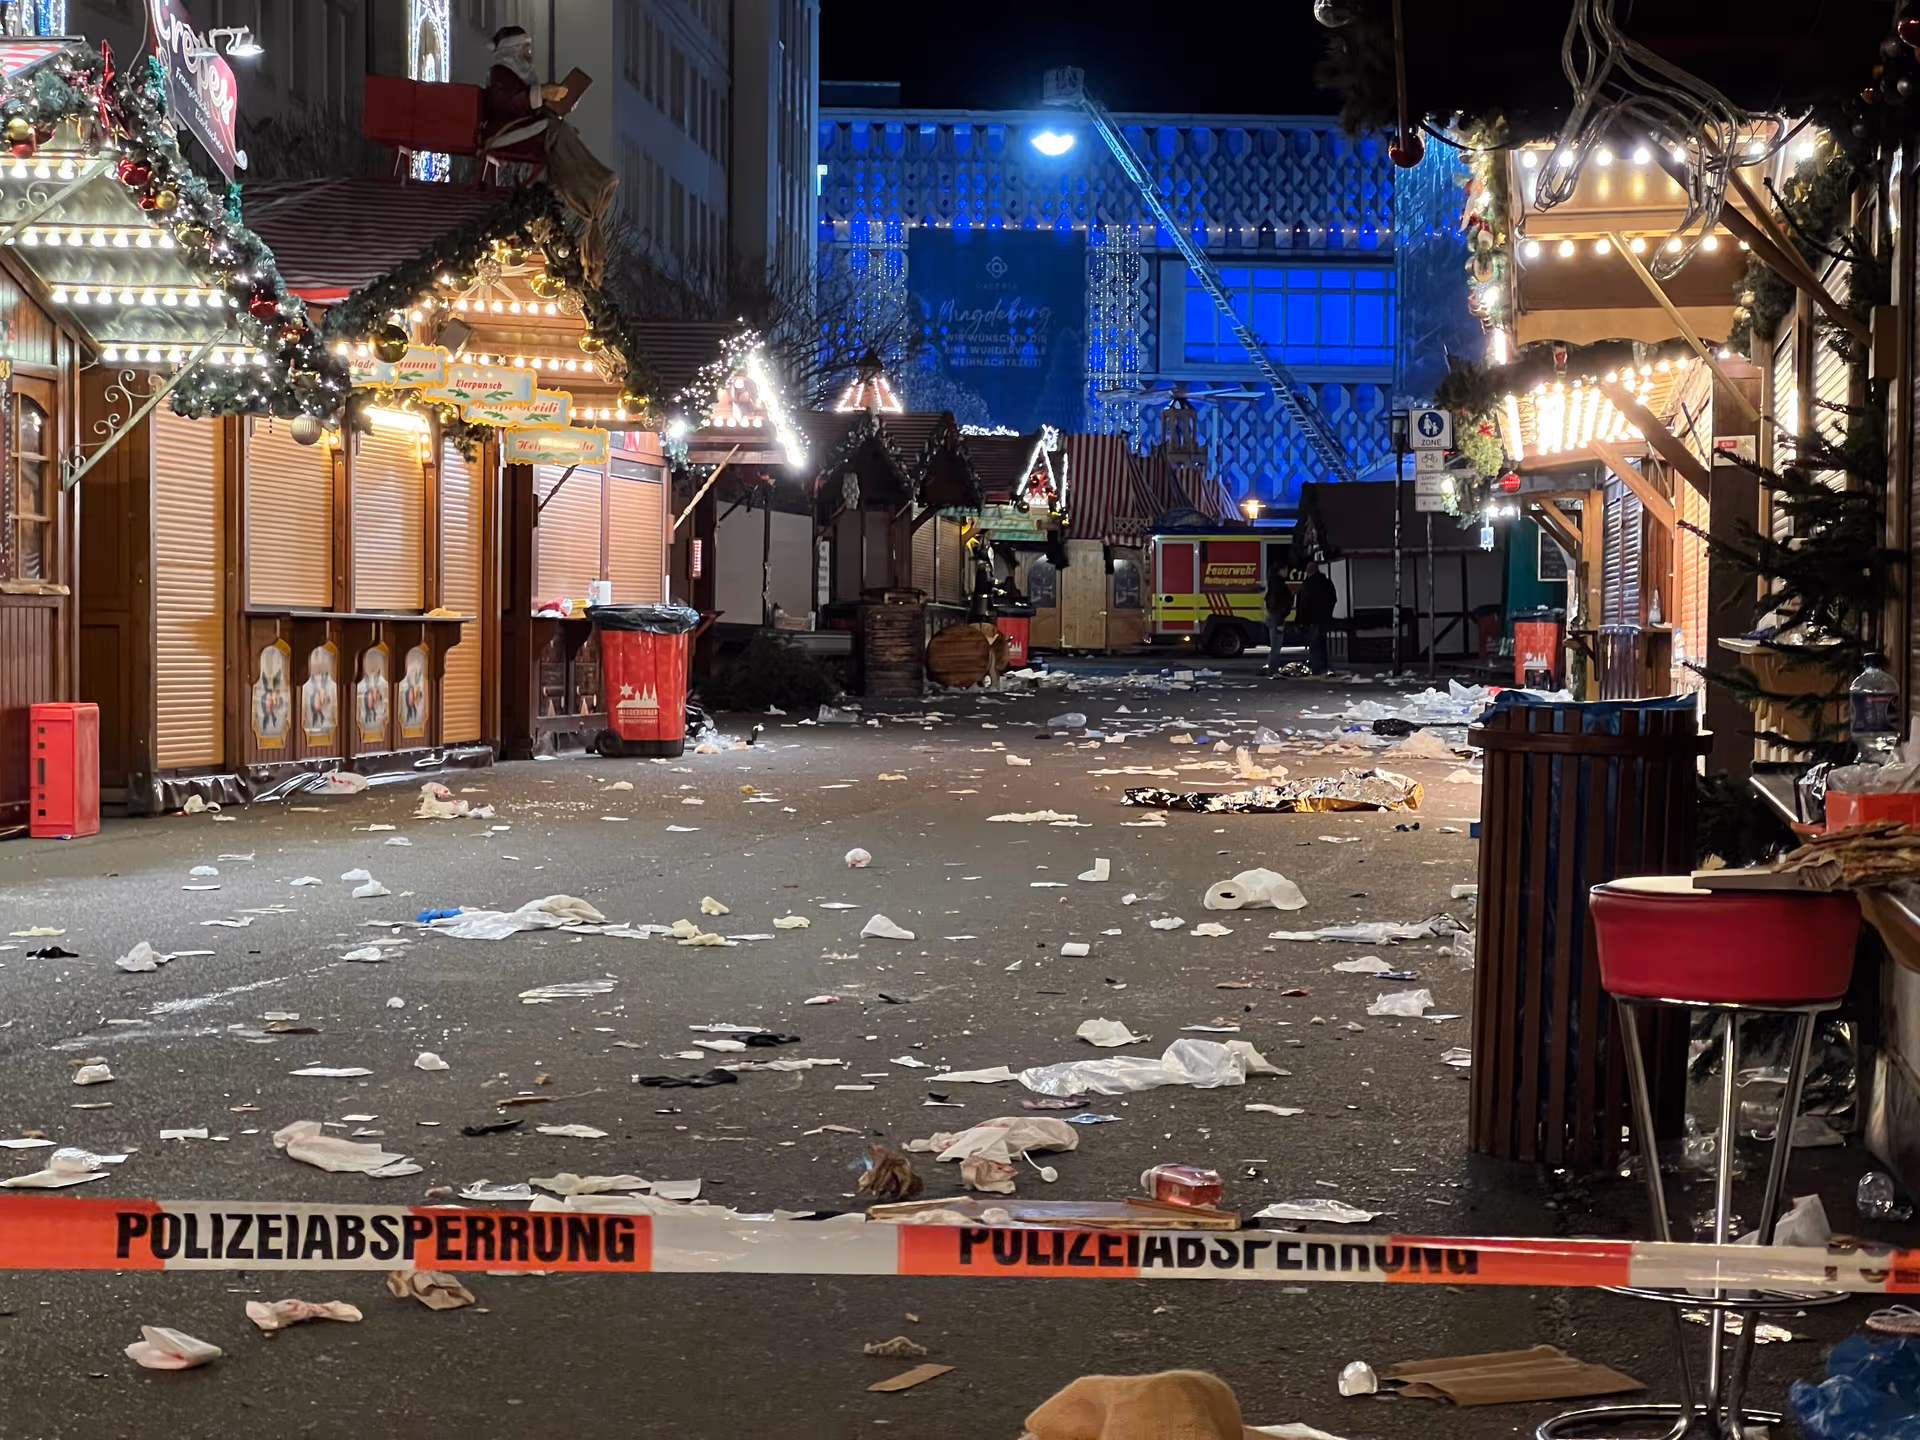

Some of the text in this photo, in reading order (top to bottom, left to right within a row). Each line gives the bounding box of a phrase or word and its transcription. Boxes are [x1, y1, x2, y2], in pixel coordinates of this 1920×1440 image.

[195, 108, 225, 154] Eierkuchen
[938, 296, 1053, 337] Magdeburg
[1206, 563, 1256, 575] Feuerwehr
[116, 1212, 635, 1263] POLIZEIABSPERRUNG
